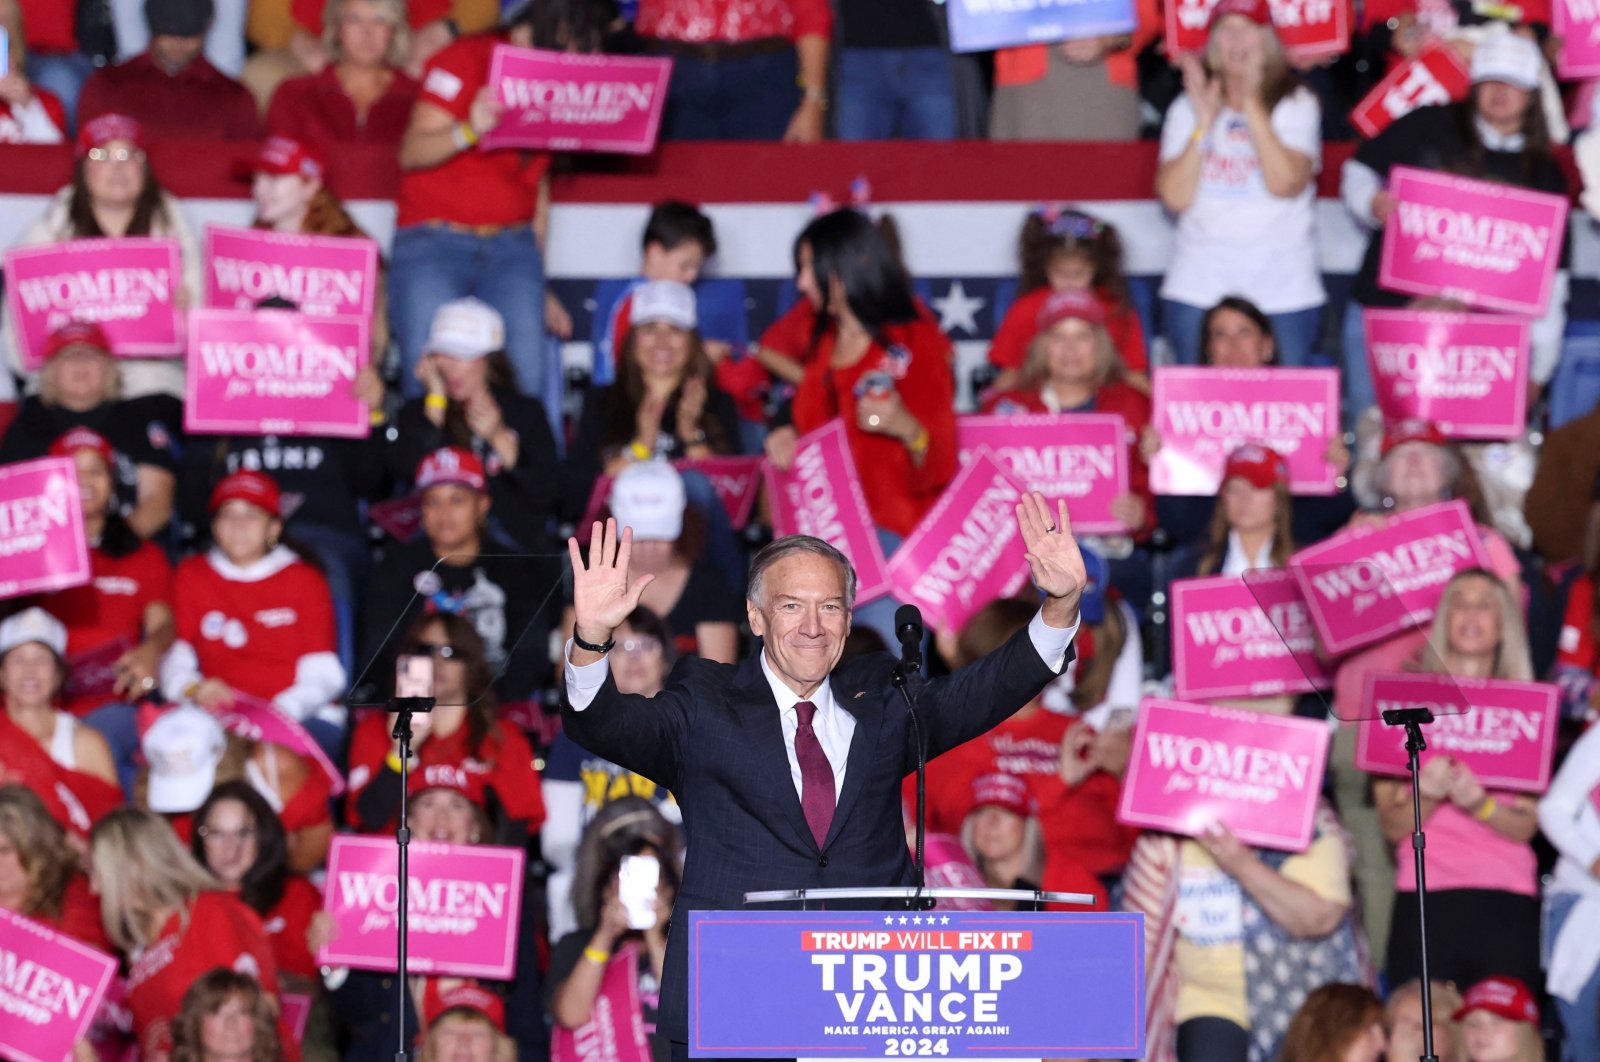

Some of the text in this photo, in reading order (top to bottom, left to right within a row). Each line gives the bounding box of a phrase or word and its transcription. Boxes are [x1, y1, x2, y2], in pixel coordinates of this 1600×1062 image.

[502, 76, 655, 111] WOMEN
[1398, 200, 1550, 262] WOMEN
[18, 268, 169, 315] WOMEN
[213, 255, 363, 304] WOMEN
[201, 341, 357, 380] WOMEN
[1372, 342, 1517, 382] WOMEN
[1167, 401, 1324, 438] WOMEN
[912, 472, 1018, 604] WOMEN
[1311, 530, 1470, 602] WOMEN
[1186, 601, 1313, 646] WOME
[1147, 731, 1311, 790] WOMEN
[1197, 774, 1279, 804] TRUMP
[339, 870, 508, 919] WOMEN
[359, 910, 390, 935] for
[812, 932, 1023, 949] TRUMP WILL FIX IT
[811, 954, 1023, 991] TRUMP
[835, 992, 998, 1022] VANCE
[824, 1025, 1010, 1035] MAKE AMERICA GREAT AGAIN!
[885, 1038, 950, 1056] 2024
